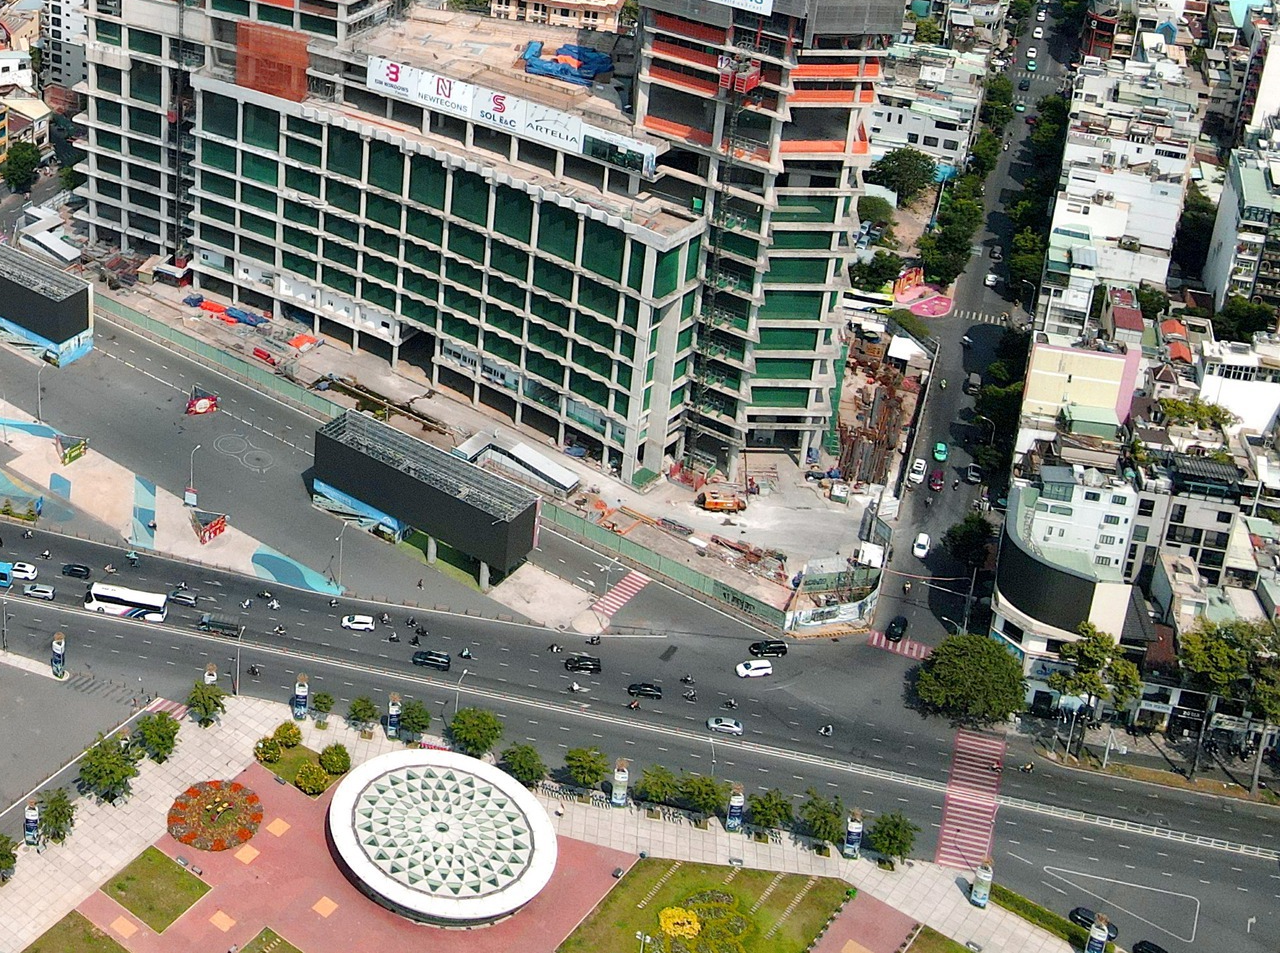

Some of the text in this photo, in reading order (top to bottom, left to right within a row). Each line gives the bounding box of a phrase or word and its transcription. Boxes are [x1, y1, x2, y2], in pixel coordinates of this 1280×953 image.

[418, 92, 468, 112] NEWTECONS
[480, 110, 497, 122] SOL
[500, 117, 517, 128] E&C
[526, 122, 579, 144] ARTELIA
